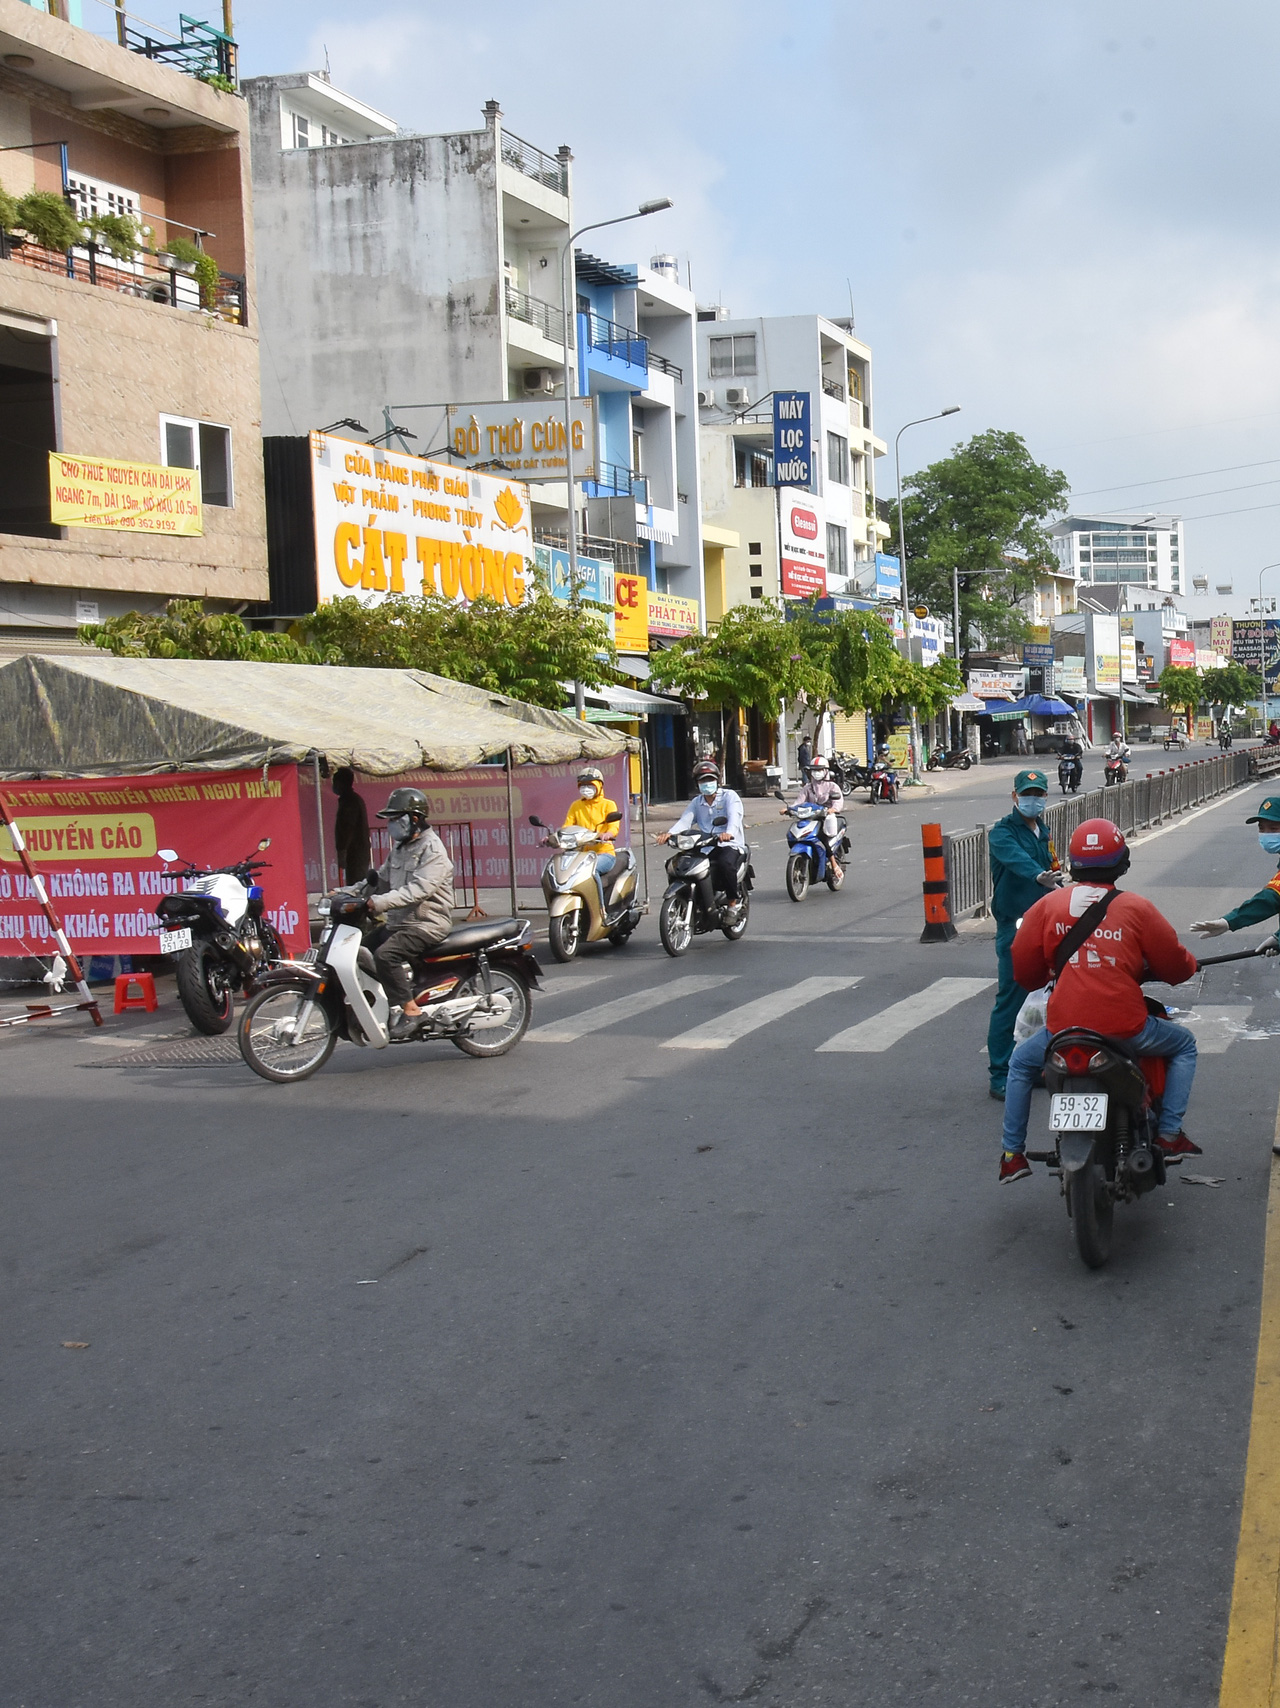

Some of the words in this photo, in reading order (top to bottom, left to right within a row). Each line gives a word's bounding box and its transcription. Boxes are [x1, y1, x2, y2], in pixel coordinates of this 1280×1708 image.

[779, 396, 804, 419] MÁY
[454, 414, 480, 456] ĐỒ
[487, 417, 525, 454] THỜ
[531, 416, 584, 452] CÚNG
[780, 429, 803, 453] LỌC
[61, 461, 79, 478] CHO
[82, 461, 104, 481] THUÊ
[107, 466, 139, 486] NGUYÊN
[160, 470, 172, 489] DÀI
[175, 476, 191, 494] HẠN
[345, 450, 372, 476] CỬA
[375, 460, 409, 485] HÀNG
[412, 469, 440, 495] PHẬT
[444, 476, 469, 498] GIÁO
[777, 455, 808, 482] NƯỚC
[56, 486, 84, 505] NGANG
[105, 488, 118, 508] DÀI
[176, 500, 198, 516] 10.5m
[333, 480, 356, 507] VẬT
[362, 484, 399, 513] PHẨM
[454, 506, 483, 529] THỦY
[120, 517, 135, 527] 090
[138, 518, 154, 528] 362
[157, 520, 176, 530] 9192
[334, 514, 408, 593] CÁT
[416, 530, 525, 607] TƯỜNG
[649, 604, 677, 621] PHÁT
[680, 607, 696, 624] TÀI
[20, 790, 54, 806] TÂM
[54, 791, 90, 808] DỊCH
[90, 787, 148, 806] TRUYỀN
[150, 783, 201, 802] NHIỄM
[202, 782, 241, 800] NGUY
[101, 822, 142, 849] CÁO
[51, 868, 108, 897] KHÔNG
[113, 872, 135, 896] RA
[65, 908, 109, 939] KHÁC
[163, 931, 186, 943] 59-A3
[1060, 1097, 1099, 1111] 59-S2
[1053, 1113, 1103, 1128] 570.72
